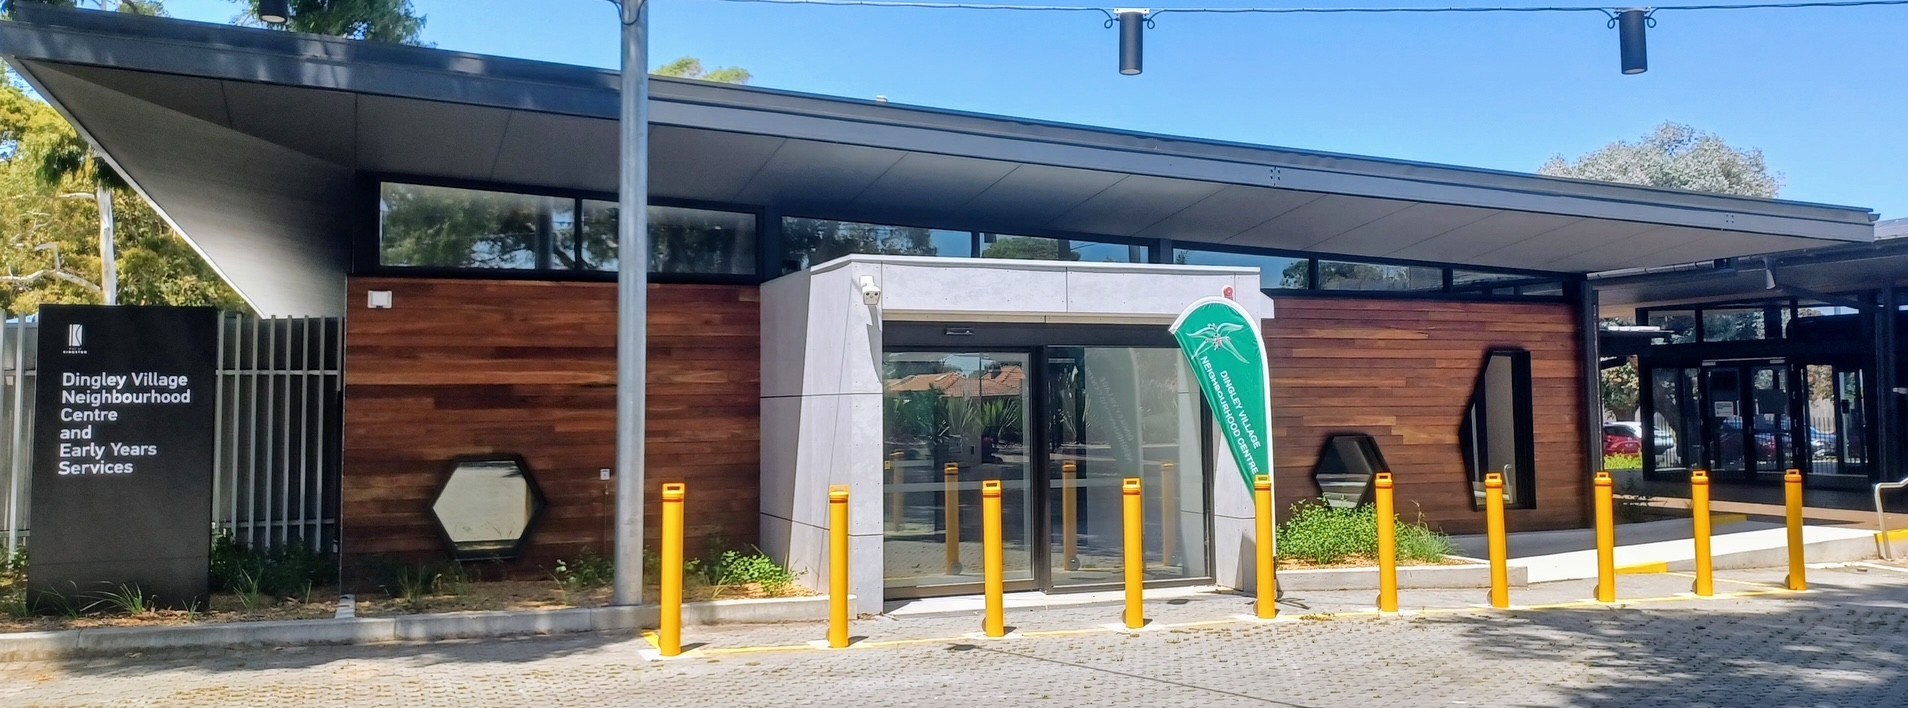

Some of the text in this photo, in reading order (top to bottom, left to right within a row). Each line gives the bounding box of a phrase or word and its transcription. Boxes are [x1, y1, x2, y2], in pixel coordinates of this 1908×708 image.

[62, 372, 188, 389] Dingley Village
[61, 389, 191, 406] Neighbourhood
[61, 408, 118, 421] Centre
[1200, 355, 1259, 475] NEIGHBOURHOOD CENTRE
[1220, 370, 1261, 449] DINGLEY VILLAGE
[60, 425, 92, 439] and
[59, 442, 157, 459] Early Years
[58, 461, 133, 475] Services
